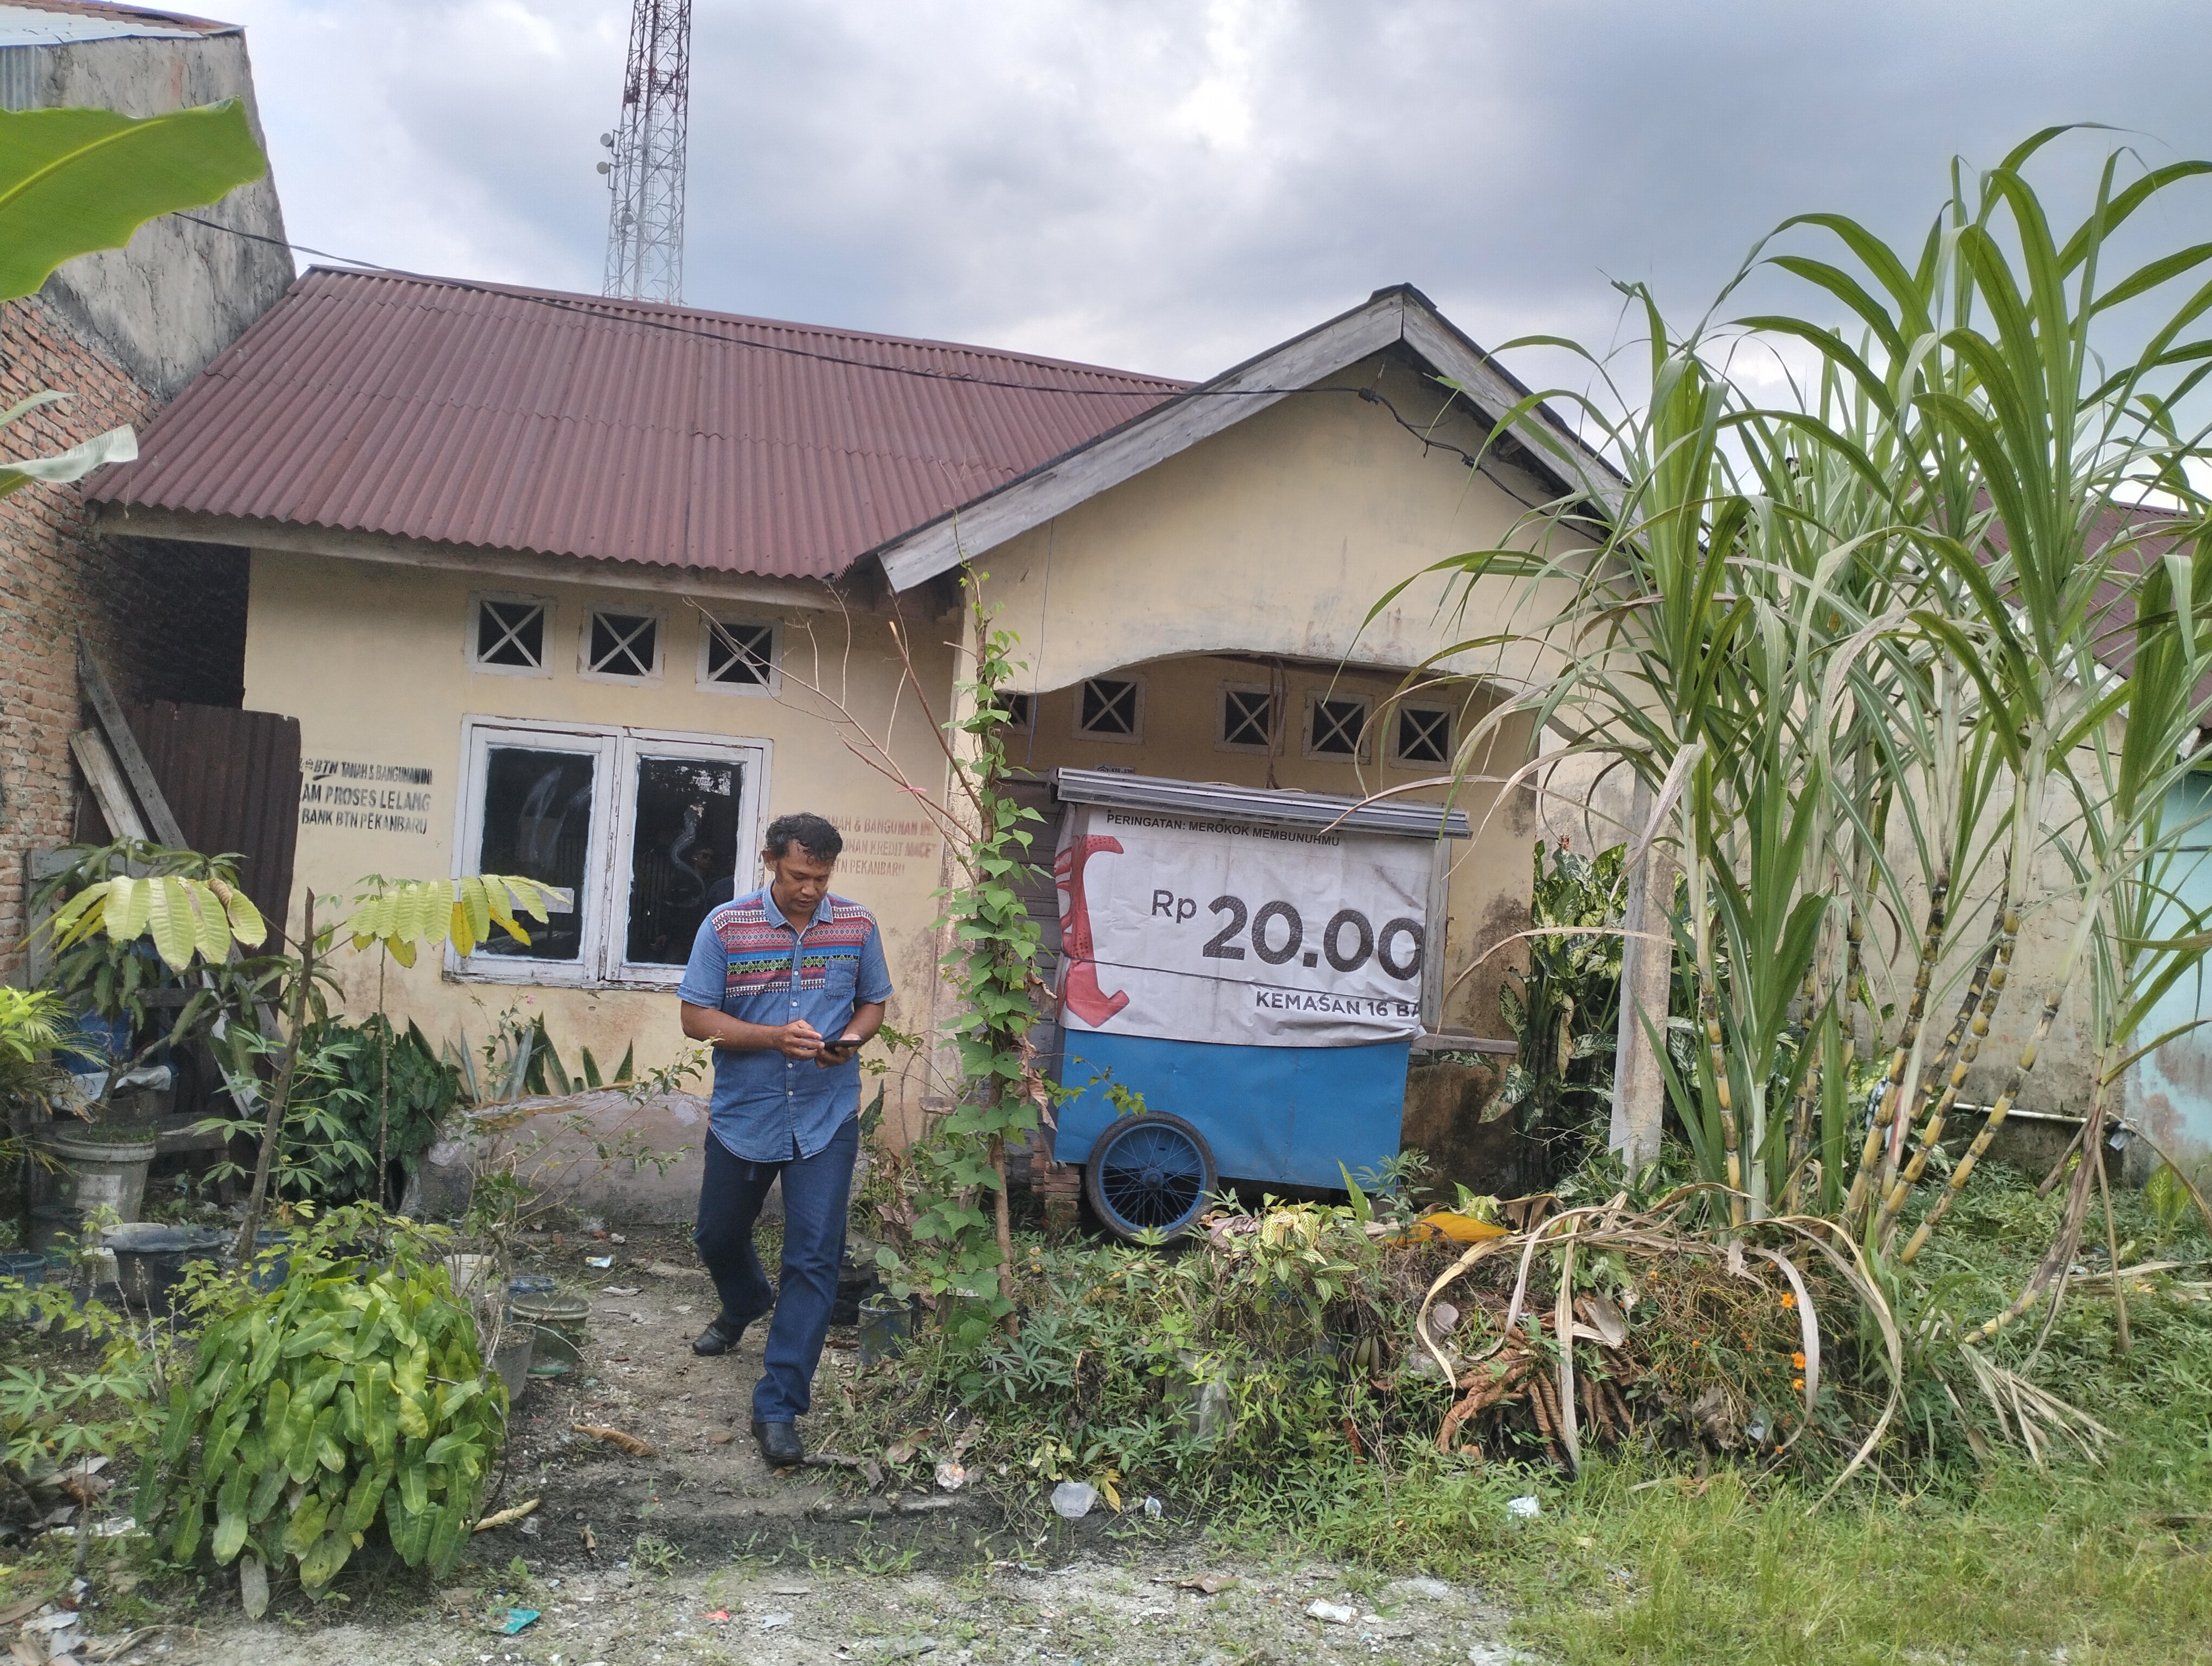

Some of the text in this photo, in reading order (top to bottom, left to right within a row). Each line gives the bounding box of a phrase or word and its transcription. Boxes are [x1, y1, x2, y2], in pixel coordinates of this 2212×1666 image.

[314, 759, 338, 774] BTN
[301, 783, 432, 812] AM PROSES LELANG
[302, 808, 427, 835] BANK BTN PEKANBARU
[864, 818, 917, 836] BANGUNAN
[1107, 814, 1340, 846] PERINGATAN: MEROKOK MEMBUNUHMU
[870, 840, 903, 856] KREDIT
[833, 857, 905, 876] TN PEKANBARU
[1152, 889, 1423, 981] Rp 20.00
[1256, 991, 1361, 1016] KEMASAN
[1367, 1002, 1388, 1017] 16
